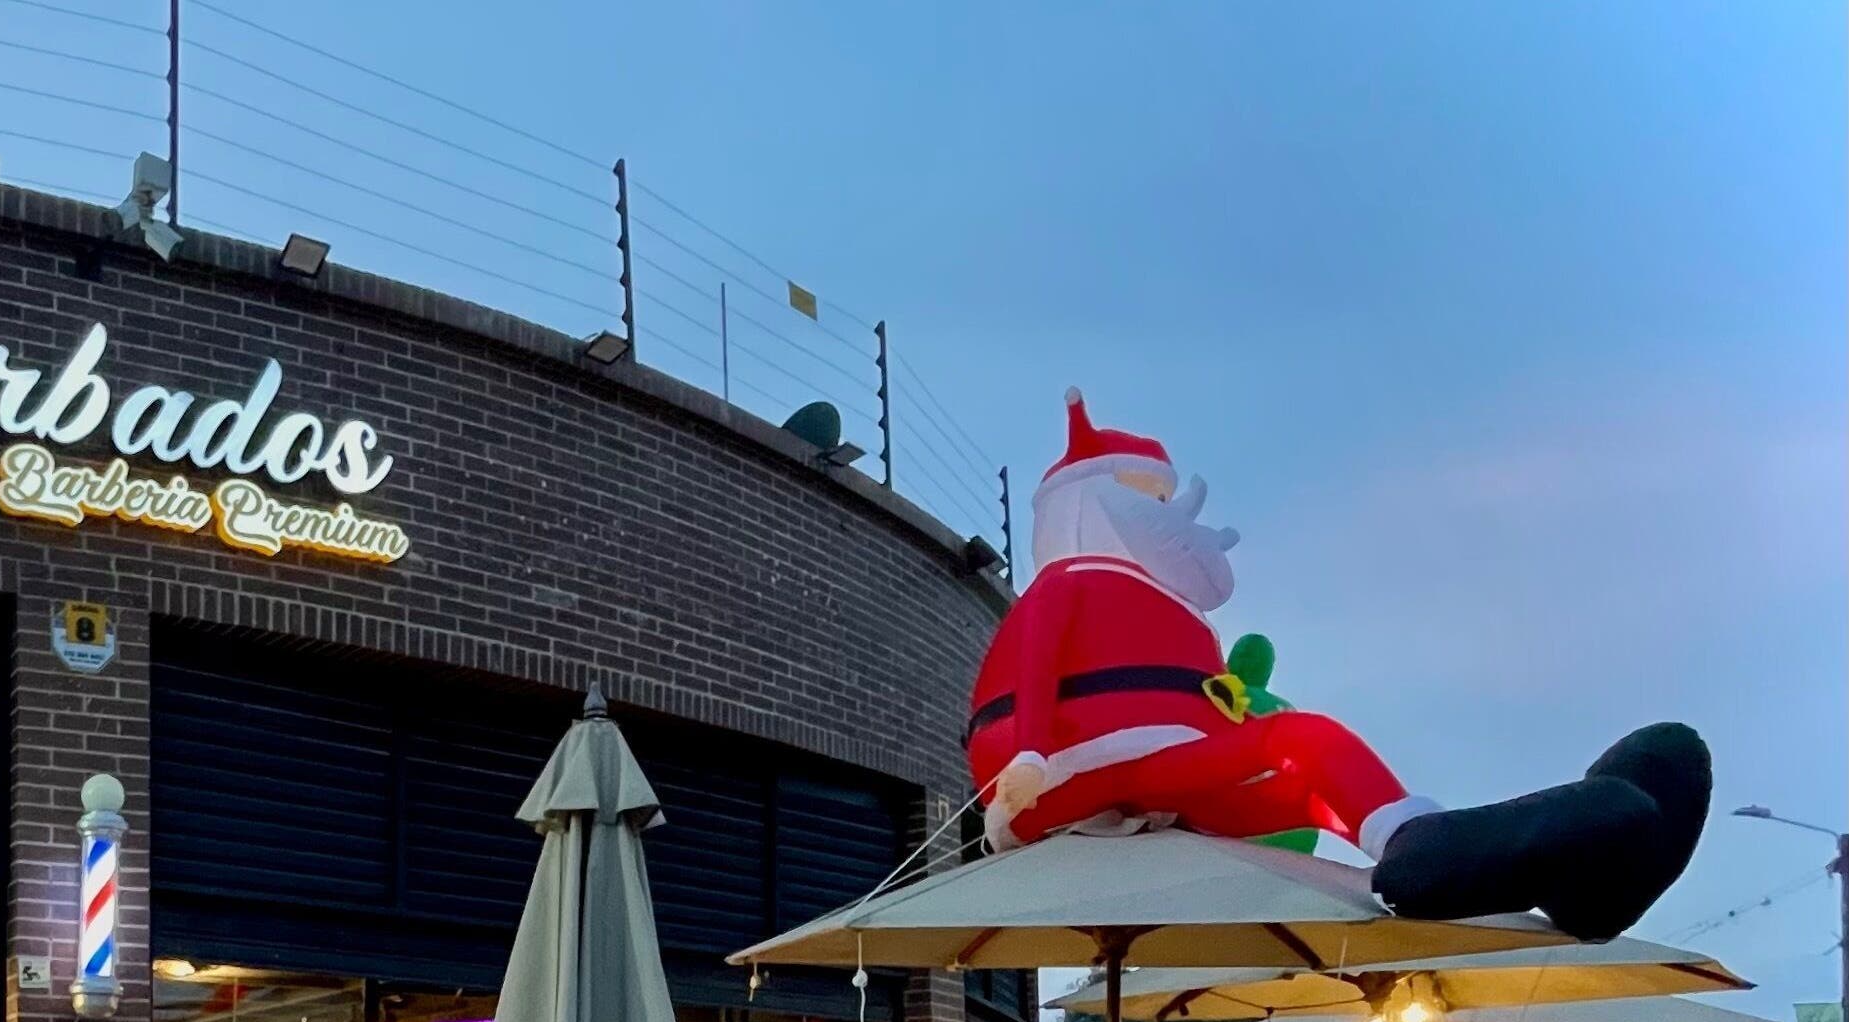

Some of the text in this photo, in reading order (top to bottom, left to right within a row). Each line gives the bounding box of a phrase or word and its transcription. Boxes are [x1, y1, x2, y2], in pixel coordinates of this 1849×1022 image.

[0, 445, 408, 558] Barberia Premium
[75, 616, 96, 641] 8
